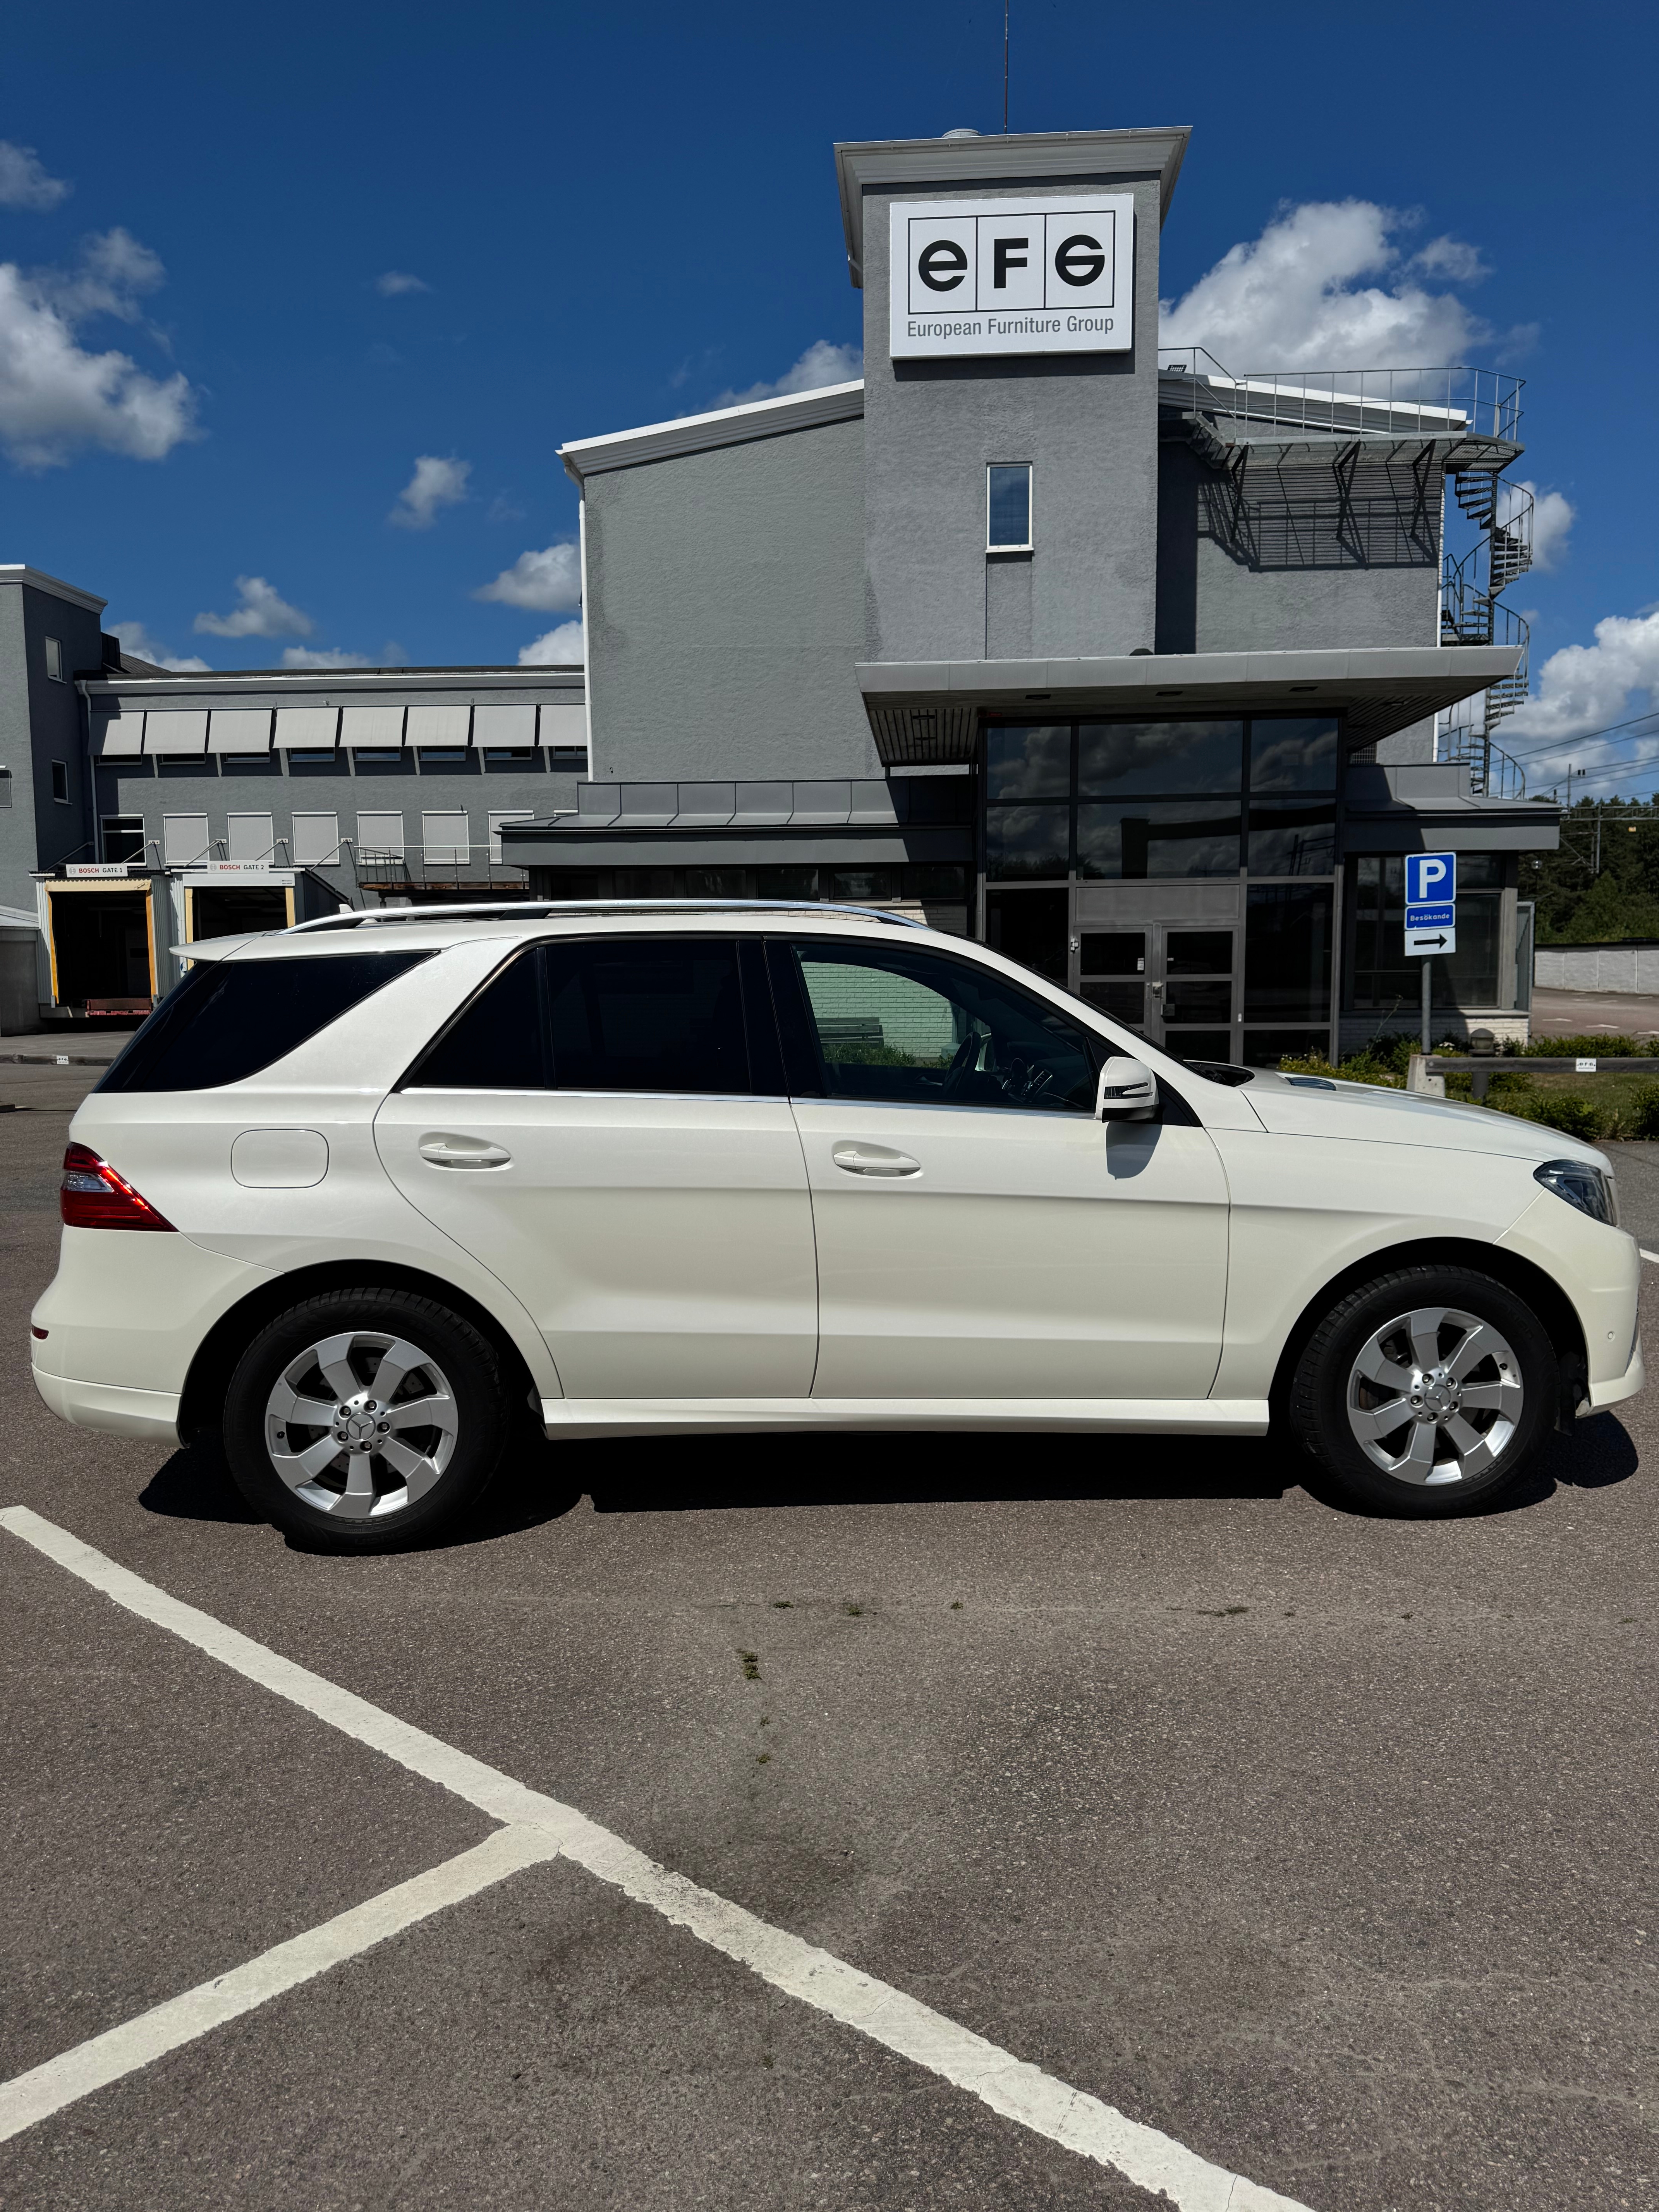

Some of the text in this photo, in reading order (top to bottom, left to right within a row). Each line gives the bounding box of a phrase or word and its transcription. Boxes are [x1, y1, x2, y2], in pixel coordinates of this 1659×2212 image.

[907, 316, 1114, 340] European Furniture Group
[1419, 859, 1446, 898] P
[1410, 913, 1450, 921] Besökande
